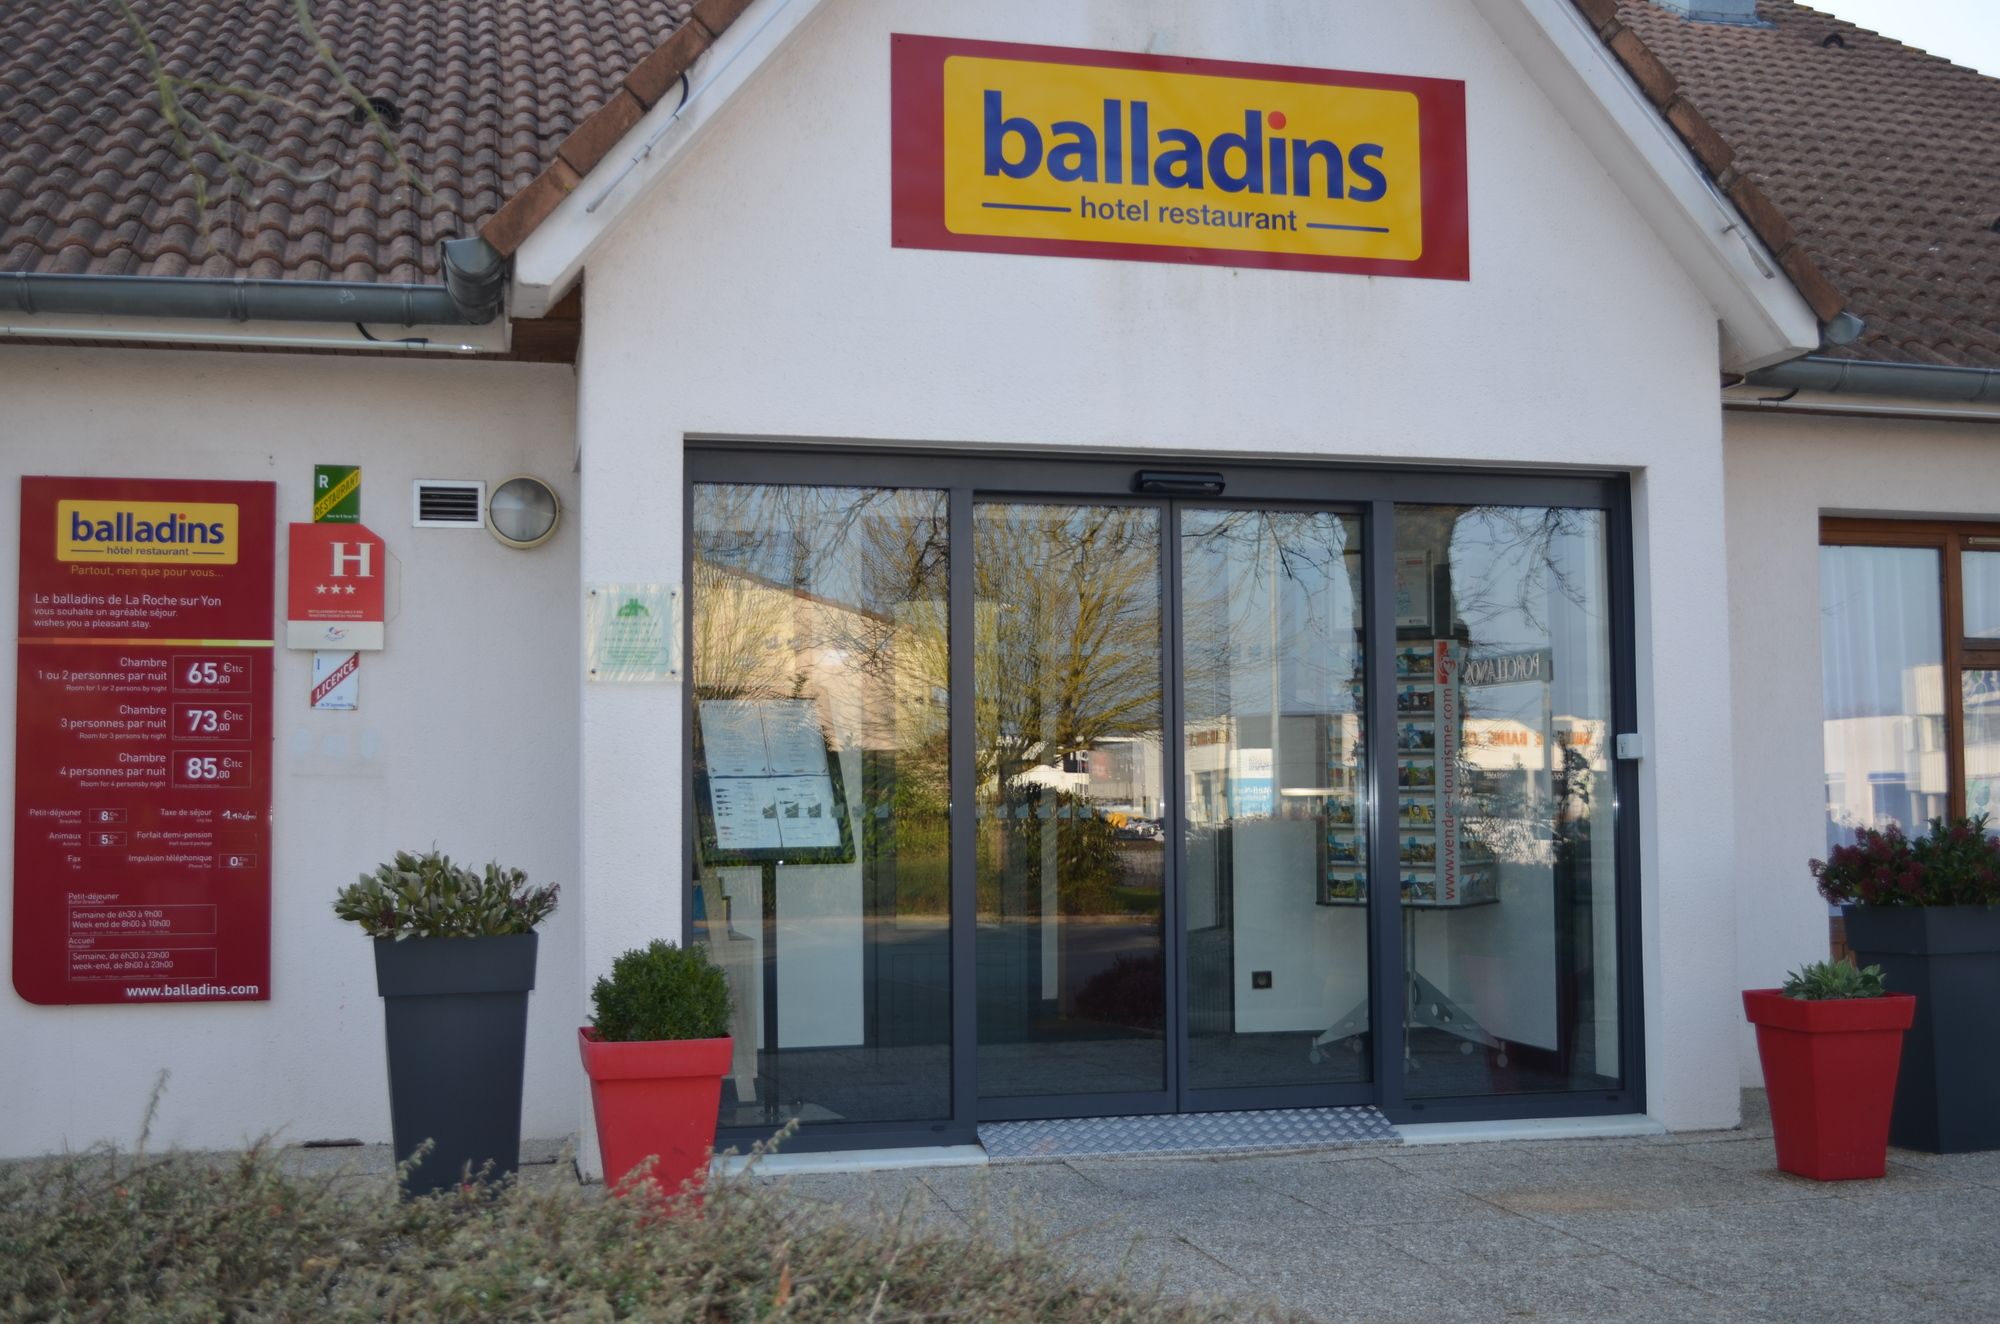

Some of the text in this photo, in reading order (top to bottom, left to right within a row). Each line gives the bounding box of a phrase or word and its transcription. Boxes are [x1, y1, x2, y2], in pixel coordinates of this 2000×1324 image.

[983, 89, 1388, 202] balladins
[1081, 196, 1297, 232] hotel restaurant
[314, 470, 360, 519] RESTAURANT
[71, 511, 225, 544] balladins
[135, 547, 189, 557] restaurant
[329, 542, 376, 577] H
[71, 564, 224, 578] Partout, rien que pour vous...
[35, 593, 222, 607] Le balladins de La Roche sur Yon
[34, 607, 178, 618] vous souhaite un agréable séjour.
[34, 619, 65, 627] wishes
[66, 620, 82, 629] you
[92, 619, 130, 629] pleasant
[131, 619, 151, 629] stay.
[120, 656, 168, 667] Chambre
[38, 669, 168, 683] 1 ou 2 personnes par nuit
[316, 658, 356, 700] LICENCE
[119, 704, 167, 715] Chambre
[61, 718, 167, 730] 3 personnes par nuit
[119, 752, 167, 763] Chambre
[60, 766, 166, 778] 4 personnes par nuit
[29, 808, 82, 818] Petit-déjeuner
[160, 807, 212, 817] Taxe de séjour
[49, 832, 82, 840] Animaux
[136, 831, 213, 840] Forfait demi-pension
[67, 854, 81, 863] Fax
[128, 853, 213, 864] Impulsion téléphonique
[68, 892, 120, 901] Petit-déjeuner
[72, 910, 163, 919] Semaine de 6h30 à 9h00
[72, 919, 171, 929] Week end de 8h00 à 10h00
[68, 937, 95, 945] Accueil
[109, 952, 119, 960] de
[120, 951, 139, 960] 6h30
[140, 951, 145, 959] à
[147, 951, 170, 959] 23h00
[113, 961, 123, 969] de
[124, 961, 143, 969] 8h00
[144, 961, 150, 969] à
[151, 960, 174, 969] 23h00
[126, 983, 259, 997] www.balladins.com
